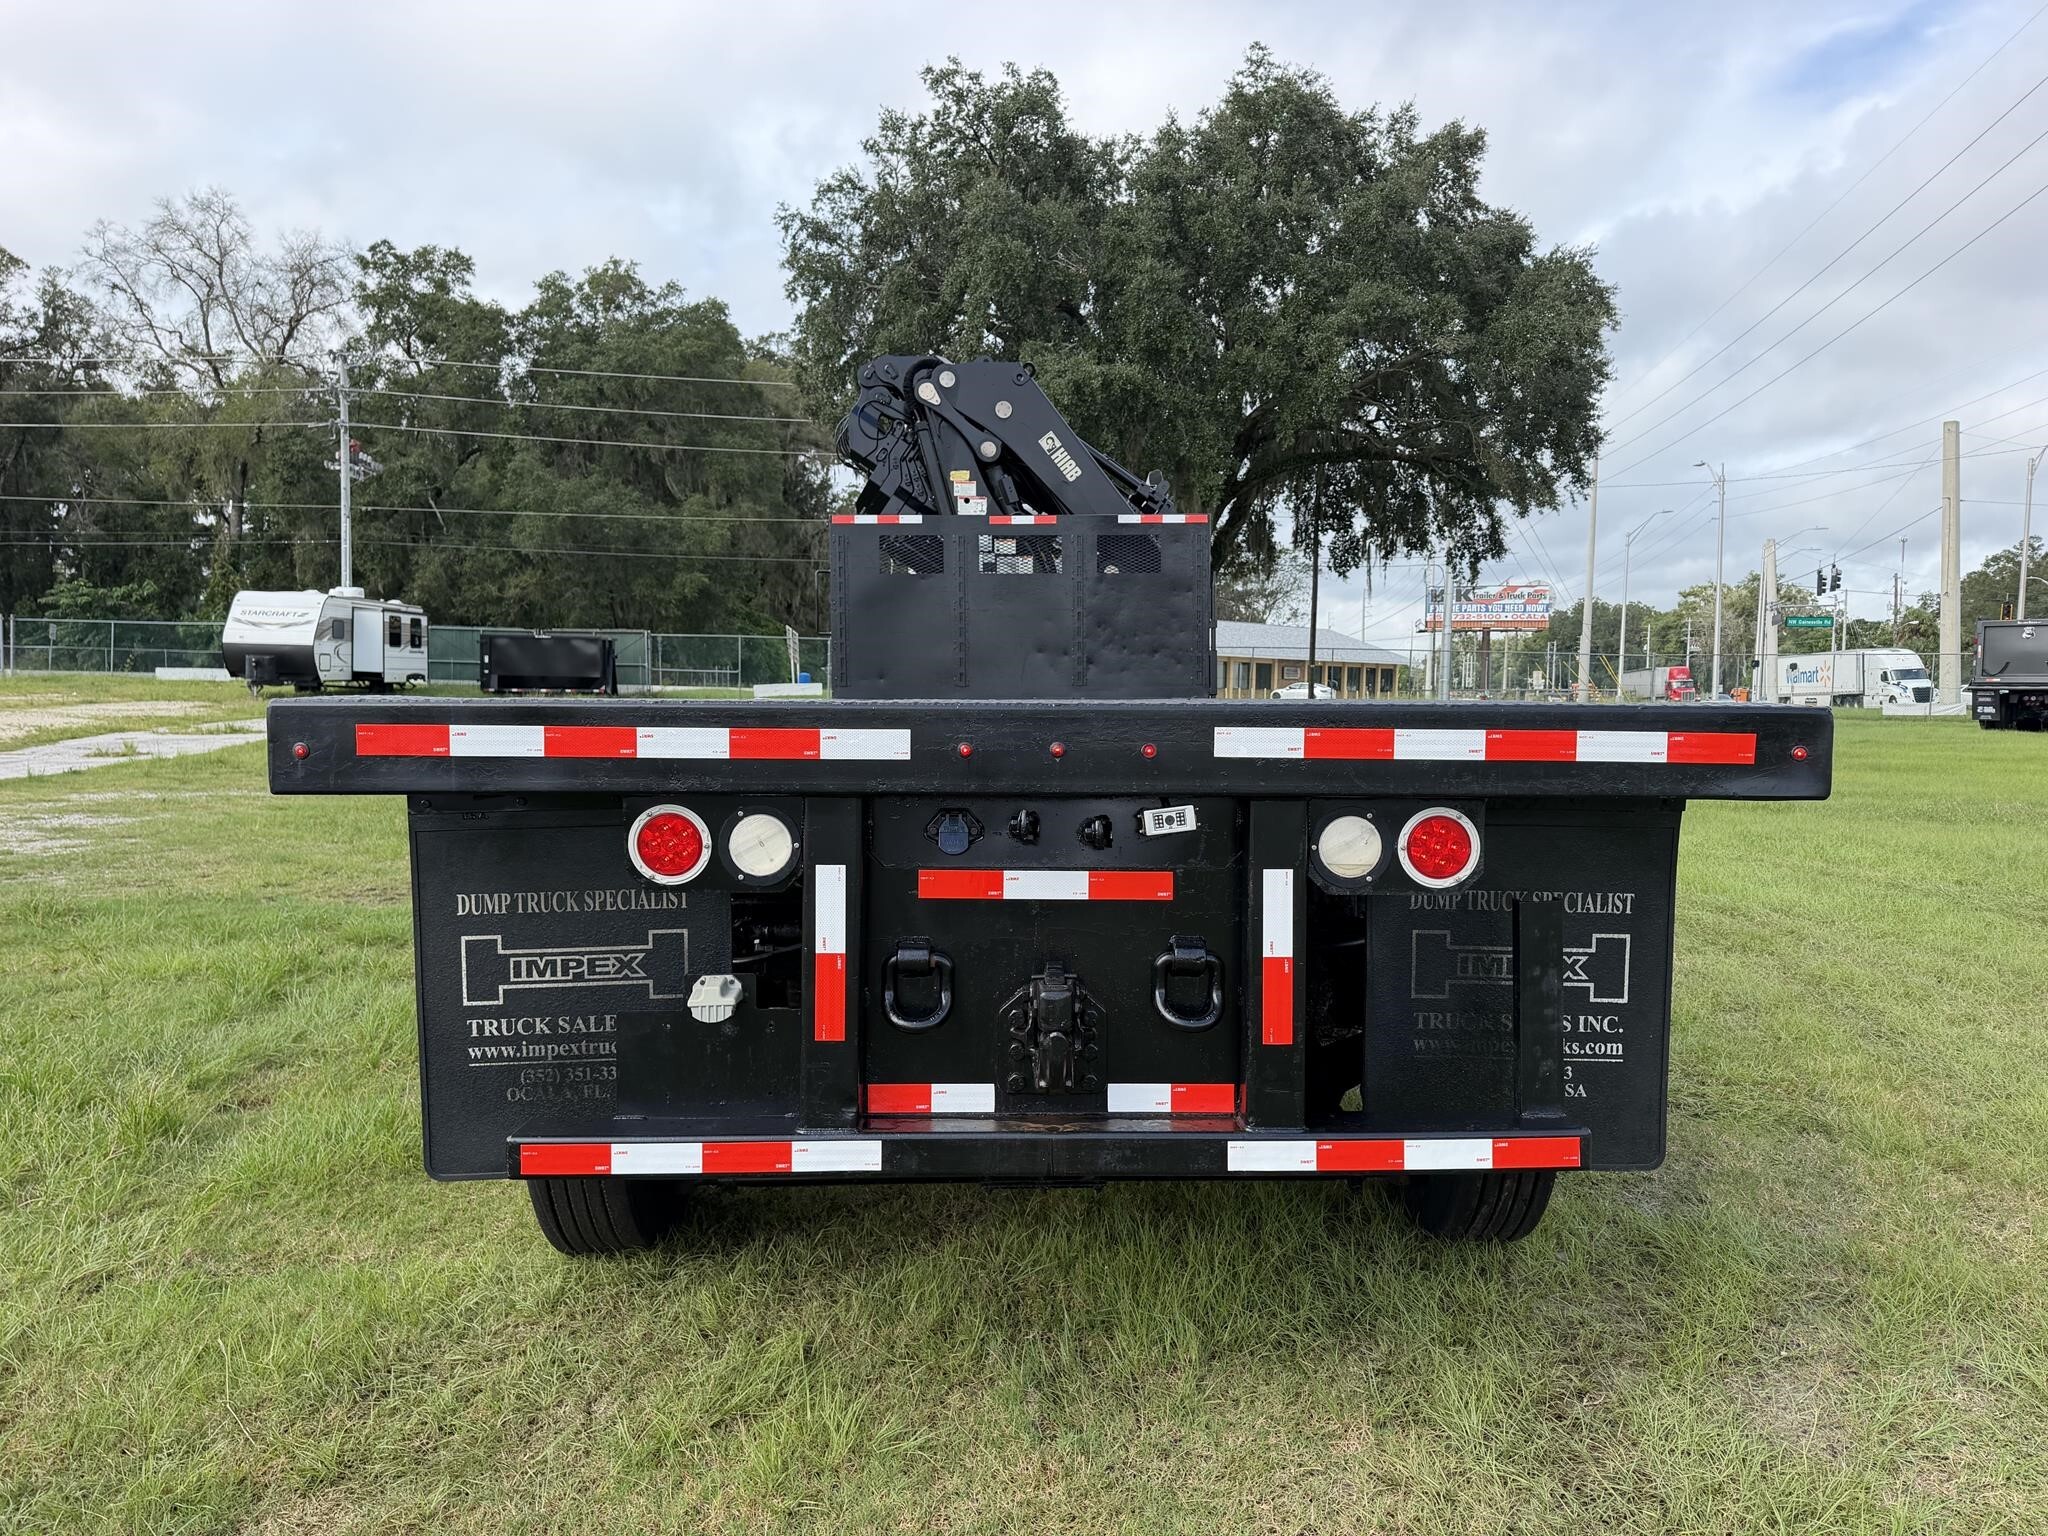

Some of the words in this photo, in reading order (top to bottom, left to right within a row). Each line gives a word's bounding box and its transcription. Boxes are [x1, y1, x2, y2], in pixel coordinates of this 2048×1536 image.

[1050, 447, 1082, 482] HIAB
[1473, 591, 1496, 599] Trailer
[240, 609, 298, 618] STARCRAFT
[1462, 604, 1486, 613] PARTS
[1488, 604, 1503, 613] YOU
[1504, 604, 1524, 613] NEED
[1526, 604, 1547, 613] NOW!
[457, 893, 511, 916] DUMP
[514, 890, 580, 914] TRUCK
[1409, 893, 1462, 911] DUMP
[510, 952, 647, 981] IMPEX
[467, 1016, 552, 1037] TRUCK
[558, 1014, 617, 1034] SALE
[1578, 1015, 1624, 1033] INC.
[467, 1040, 617, 1061] www.impextru
[566, 1066, 617, 1082] 351-33
